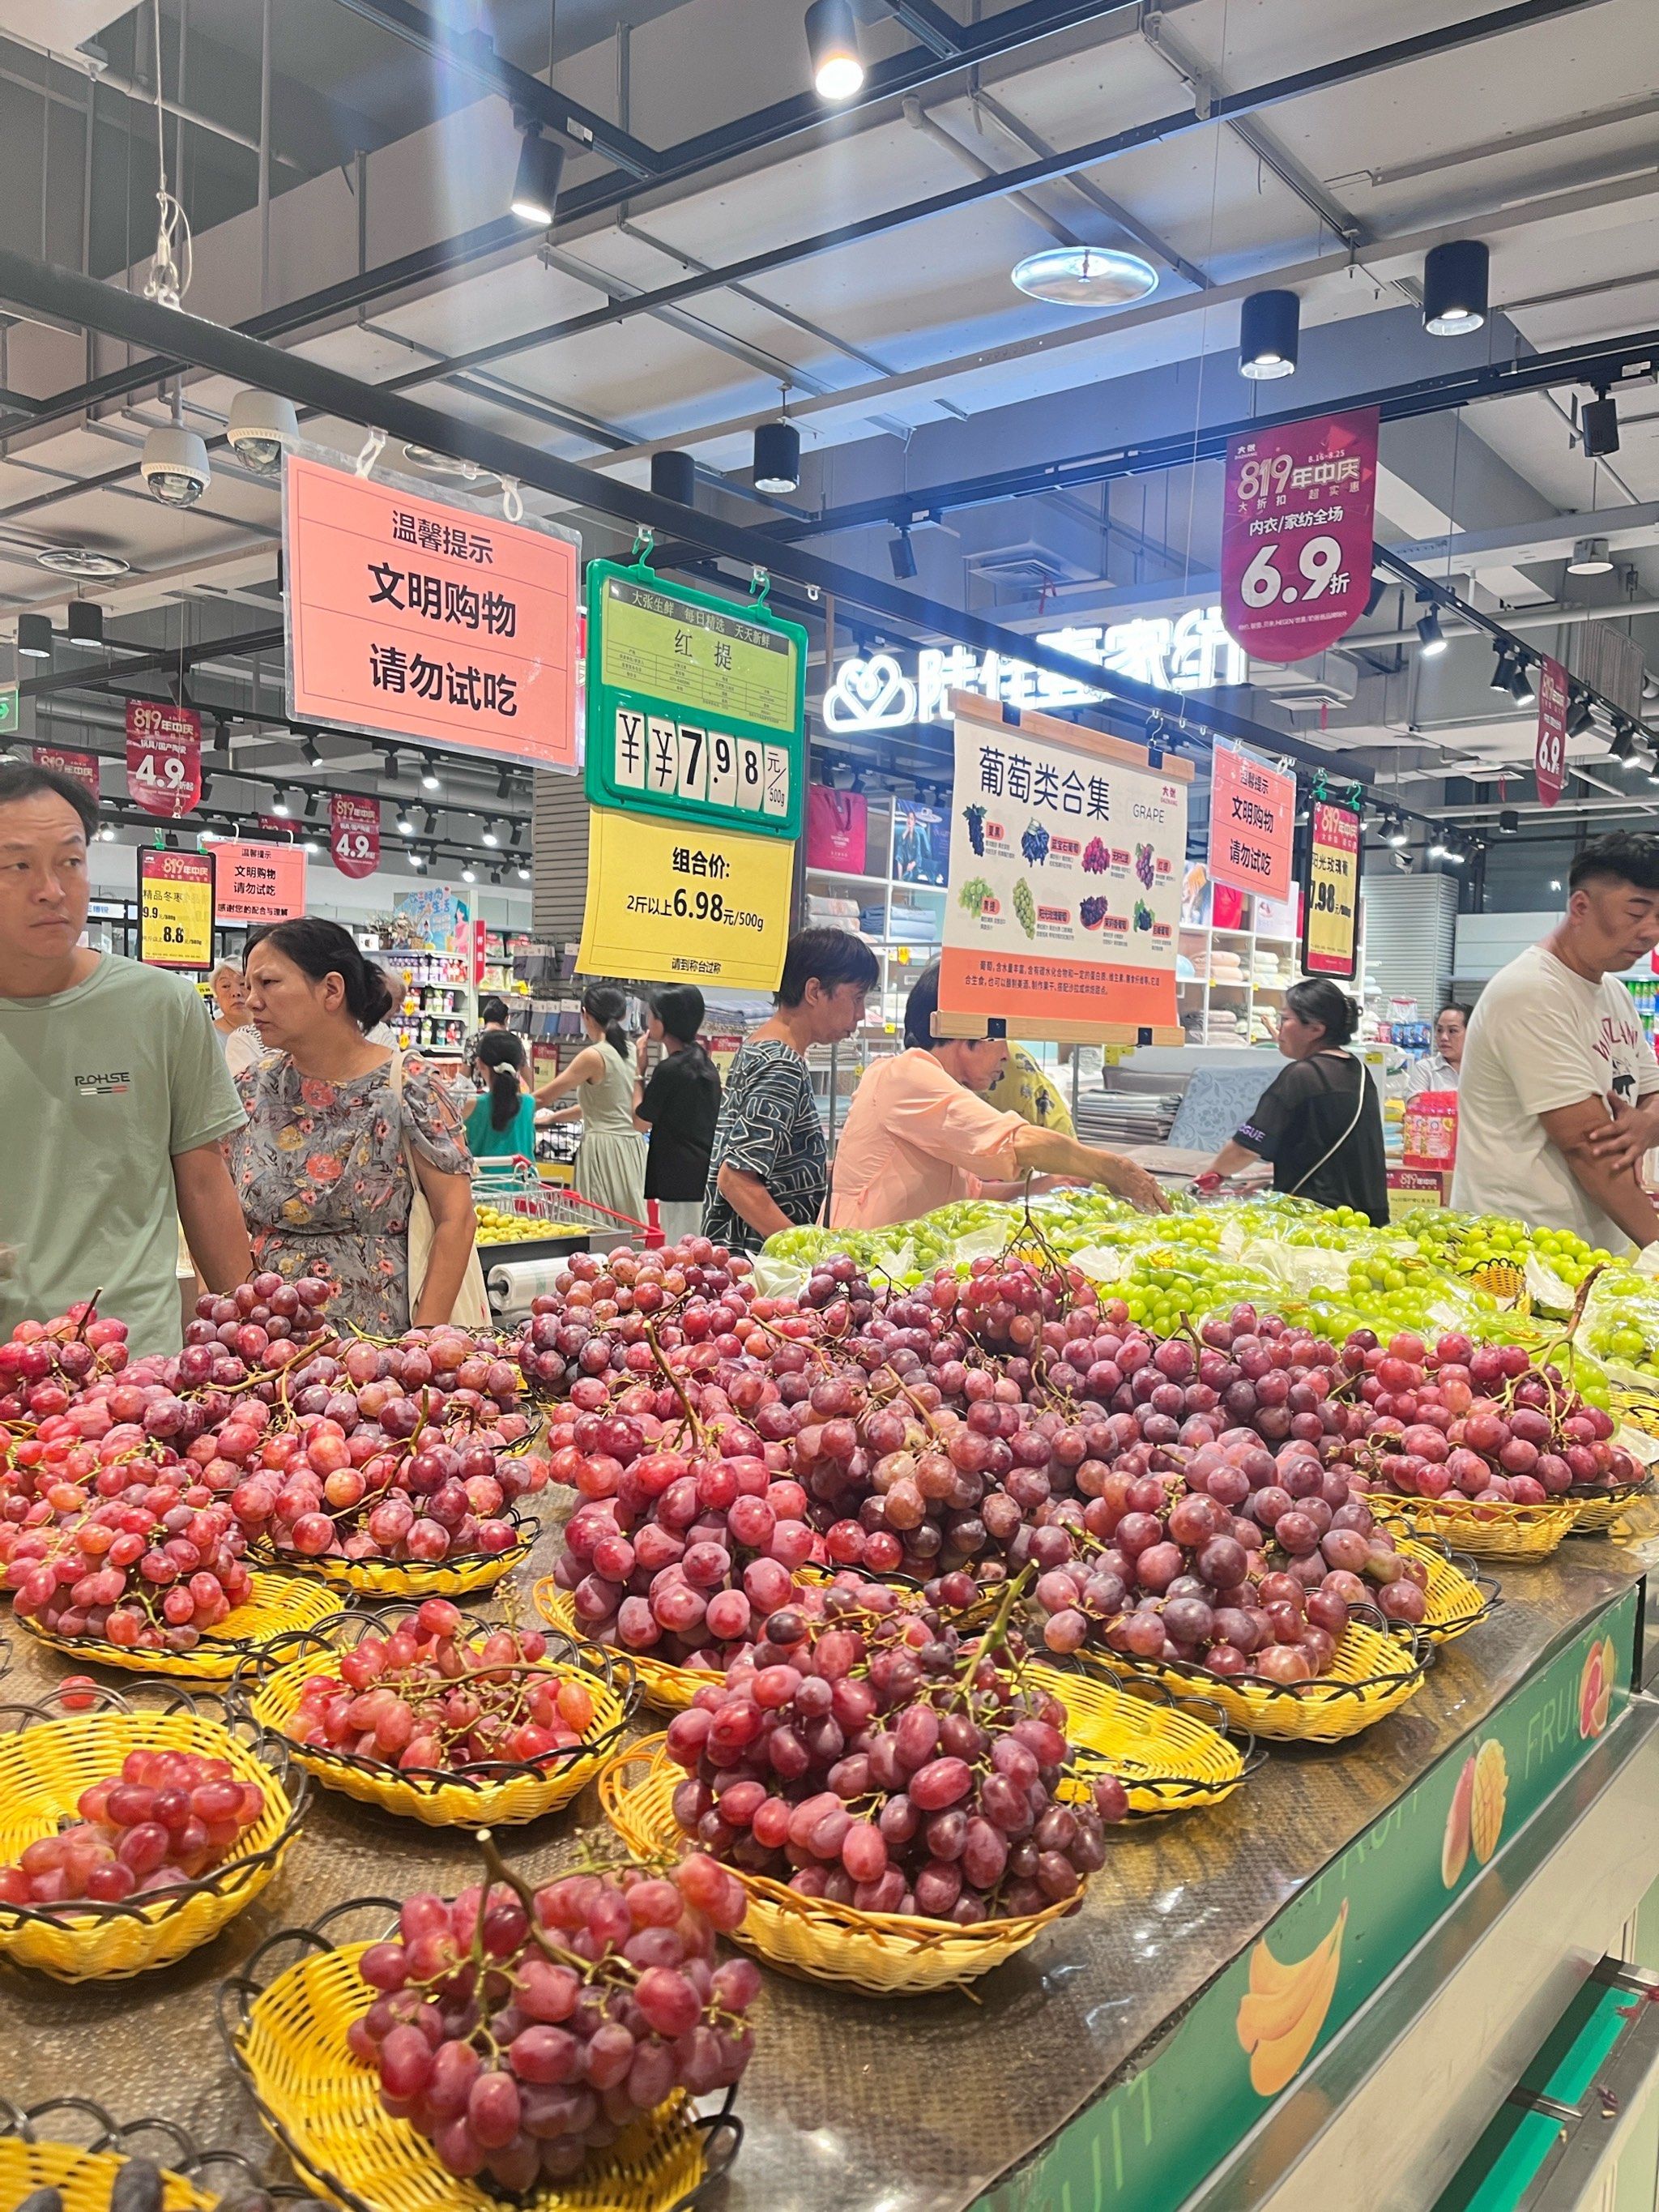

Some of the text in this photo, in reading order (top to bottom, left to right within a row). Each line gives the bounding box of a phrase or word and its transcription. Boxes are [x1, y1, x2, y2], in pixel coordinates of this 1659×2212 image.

[1250, 505, 1344, 536] 内衣/家纺全场
[392, 510, 494, 565] 温馨提示
[367, 562, 517, 638] 文明购物
[631, 589, 770, 648] 大张生鲜 每日精选 天天新鲜
[369, 643, 518, 717] 请勿试吃
[979, 745, 1111, 822] 葡萄类合集
[1132, 804, 1165, 823] GRAPE
[1231, 795, 1274, 834] 文明购物
[241, 848, 272, 860] 温馨提示
[672, 846, 731, 879] 组合价:
[1229, 838, 1273, 876] 请勿试吃
[234, 865, 277, 881] 文明购物
[143, 889, 184, 903] 精品冬枣
[233, 882, 277, 897] 请勿试吃
[217, 903, 289, 916] 感谢您的配合与理解
[671, 957, 722, 975] 请到称台过称
